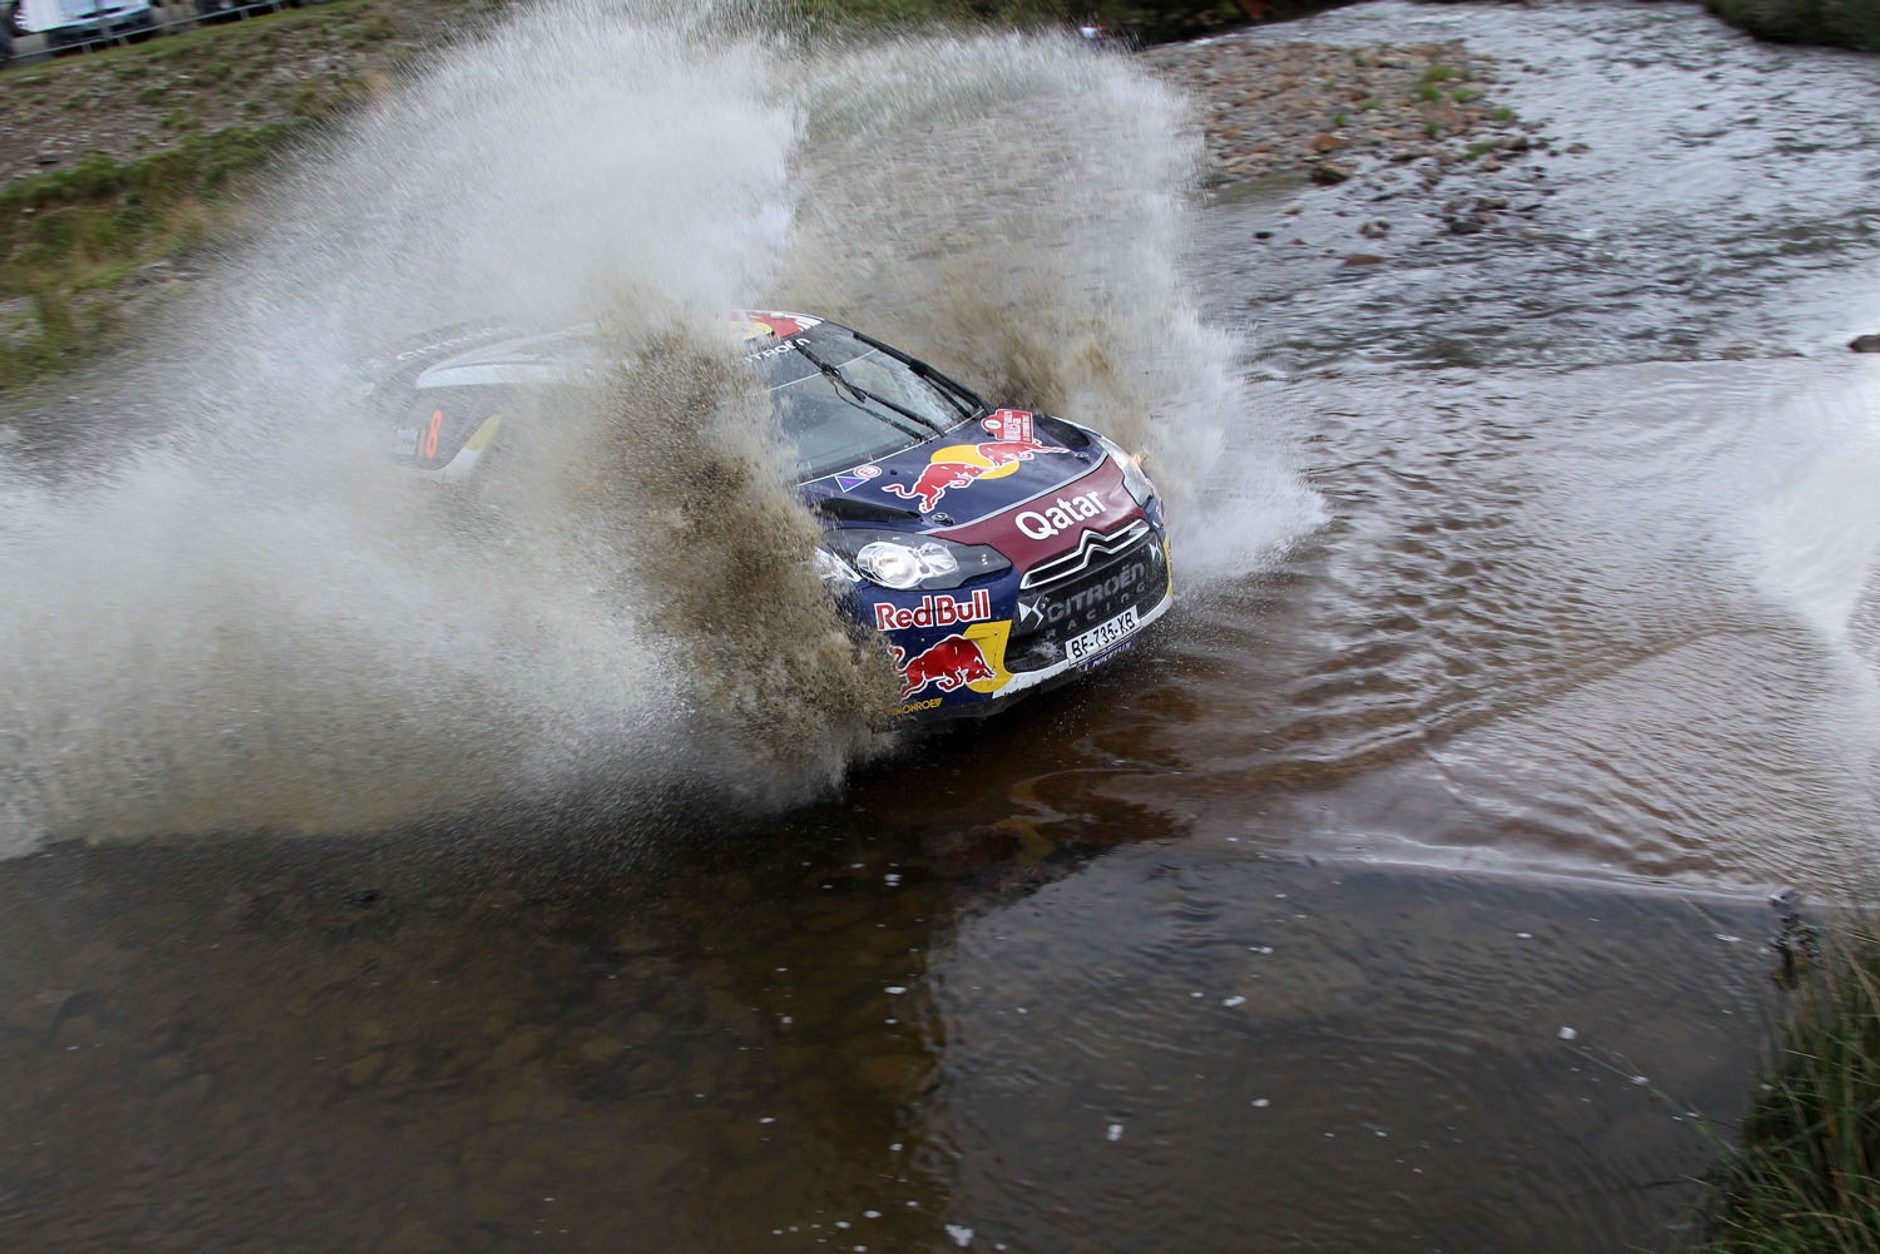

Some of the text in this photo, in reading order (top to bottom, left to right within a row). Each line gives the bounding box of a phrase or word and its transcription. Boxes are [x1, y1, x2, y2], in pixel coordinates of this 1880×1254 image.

[426, 409, 443, 459] 8
[1015, 491, 1107, 540] Qatar
[874, 589, 991, 631] Red Bull
[1071, 611, 1136, 659] BF-735-XB
